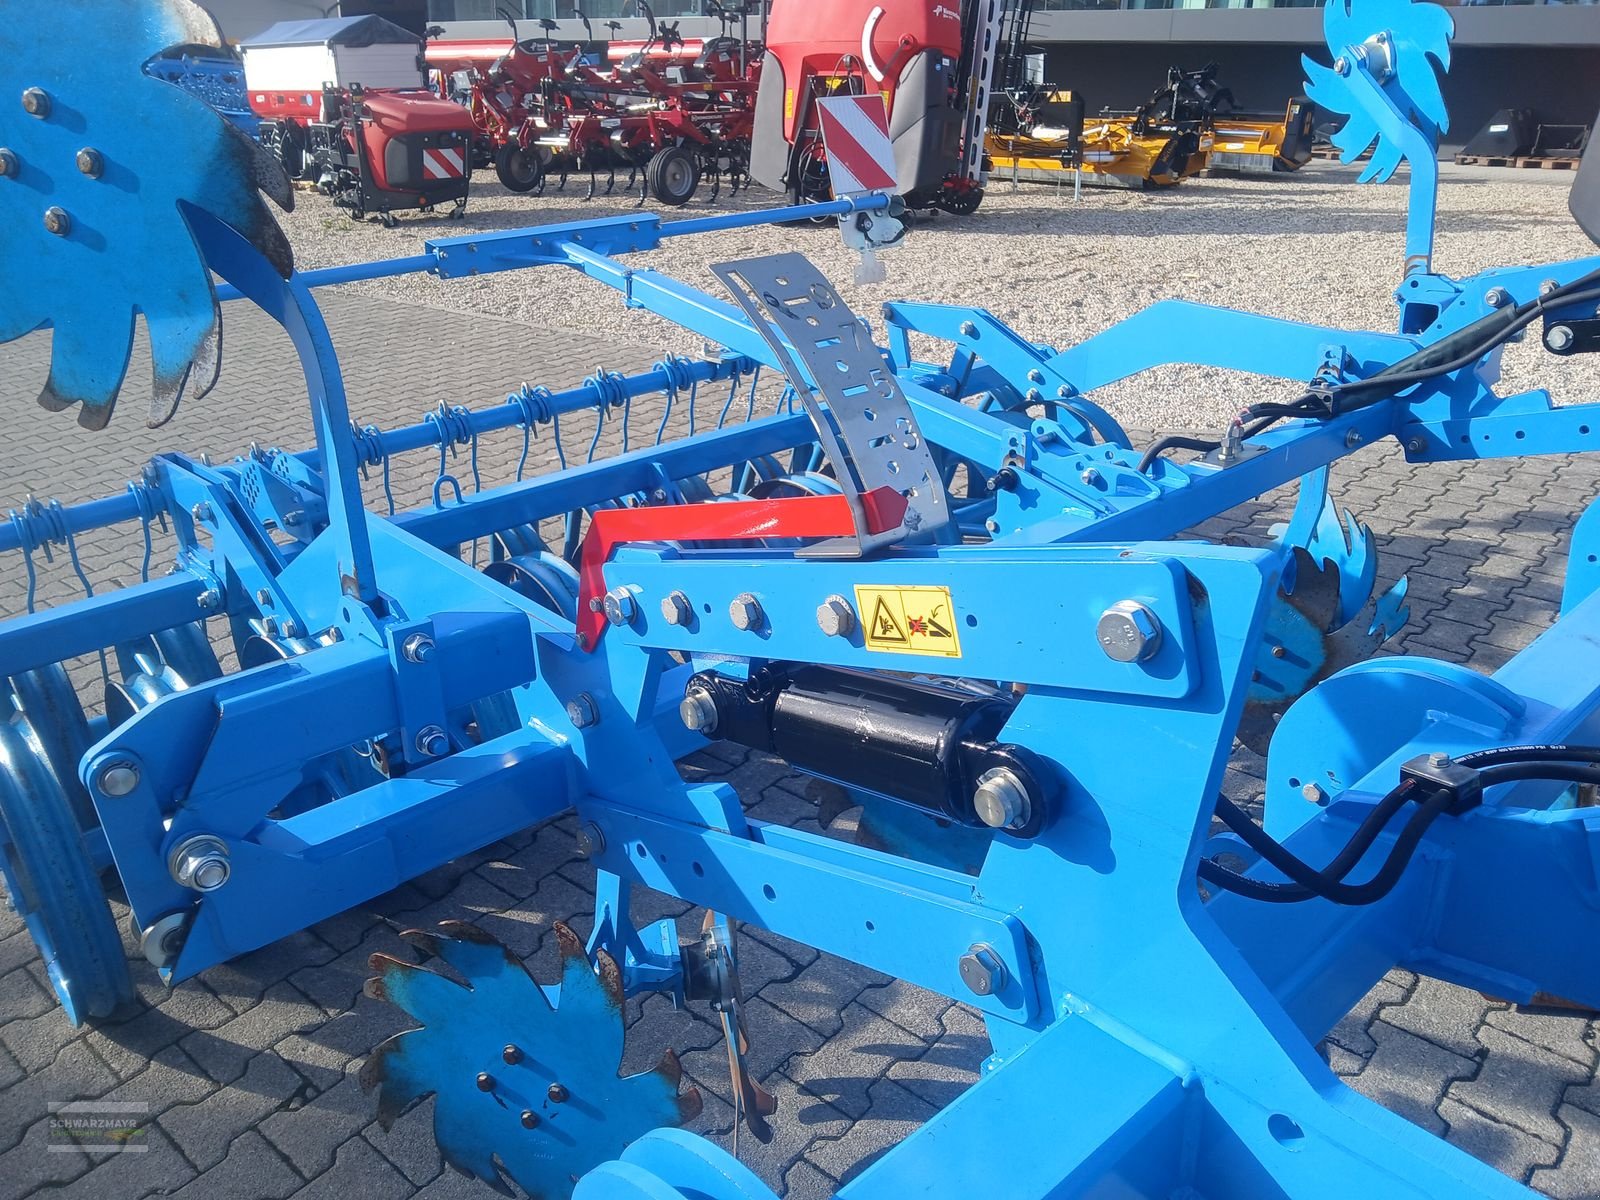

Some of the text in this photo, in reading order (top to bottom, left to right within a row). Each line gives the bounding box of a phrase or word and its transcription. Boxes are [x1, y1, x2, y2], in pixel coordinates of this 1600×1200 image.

[810, 283, 836, 310] 9
[839, 322, 861, 352] 7
[870, 369, 896, 399] 5
[895, 417, 920, 450] 3
[922, 470, 938, 504] 1
